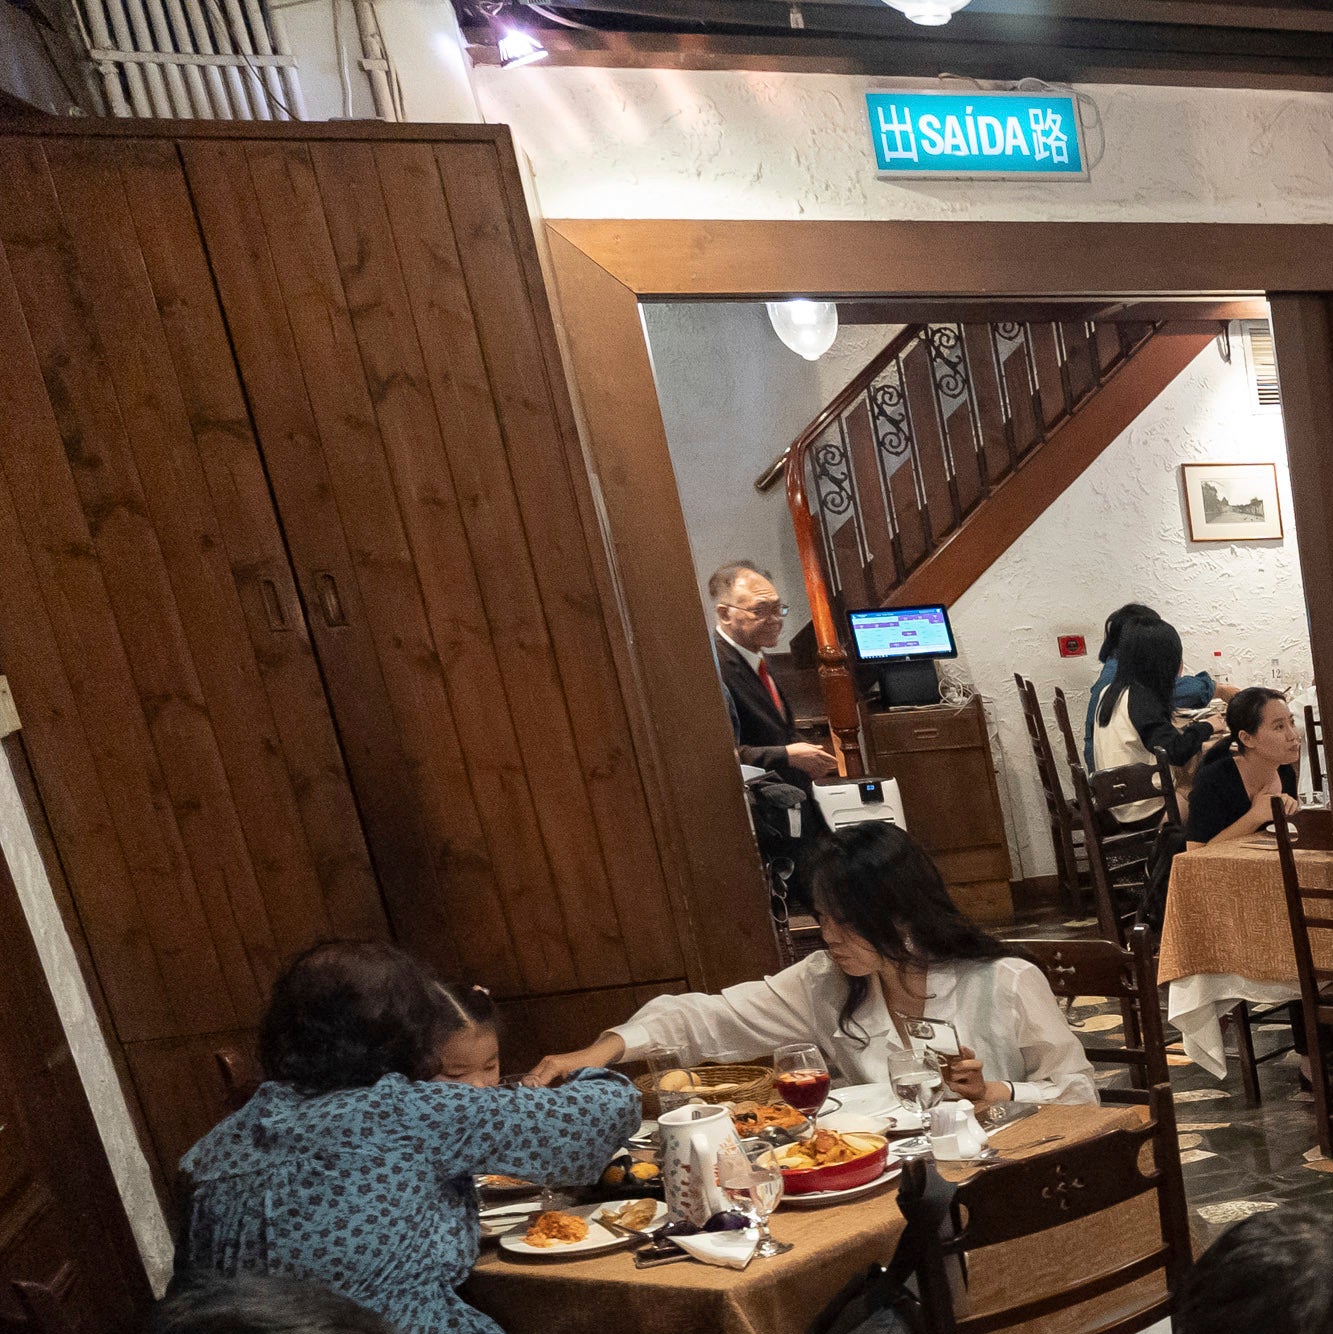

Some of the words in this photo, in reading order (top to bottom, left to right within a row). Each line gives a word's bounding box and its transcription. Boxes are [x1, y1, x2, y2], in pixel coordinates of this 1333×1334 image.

[877, 104, 919, 163] 出
[918, 106, 1030, 156] SAÍDA
[1029, 107, 1069, 164] 路
[1271, 668, 1281, 679] 12
